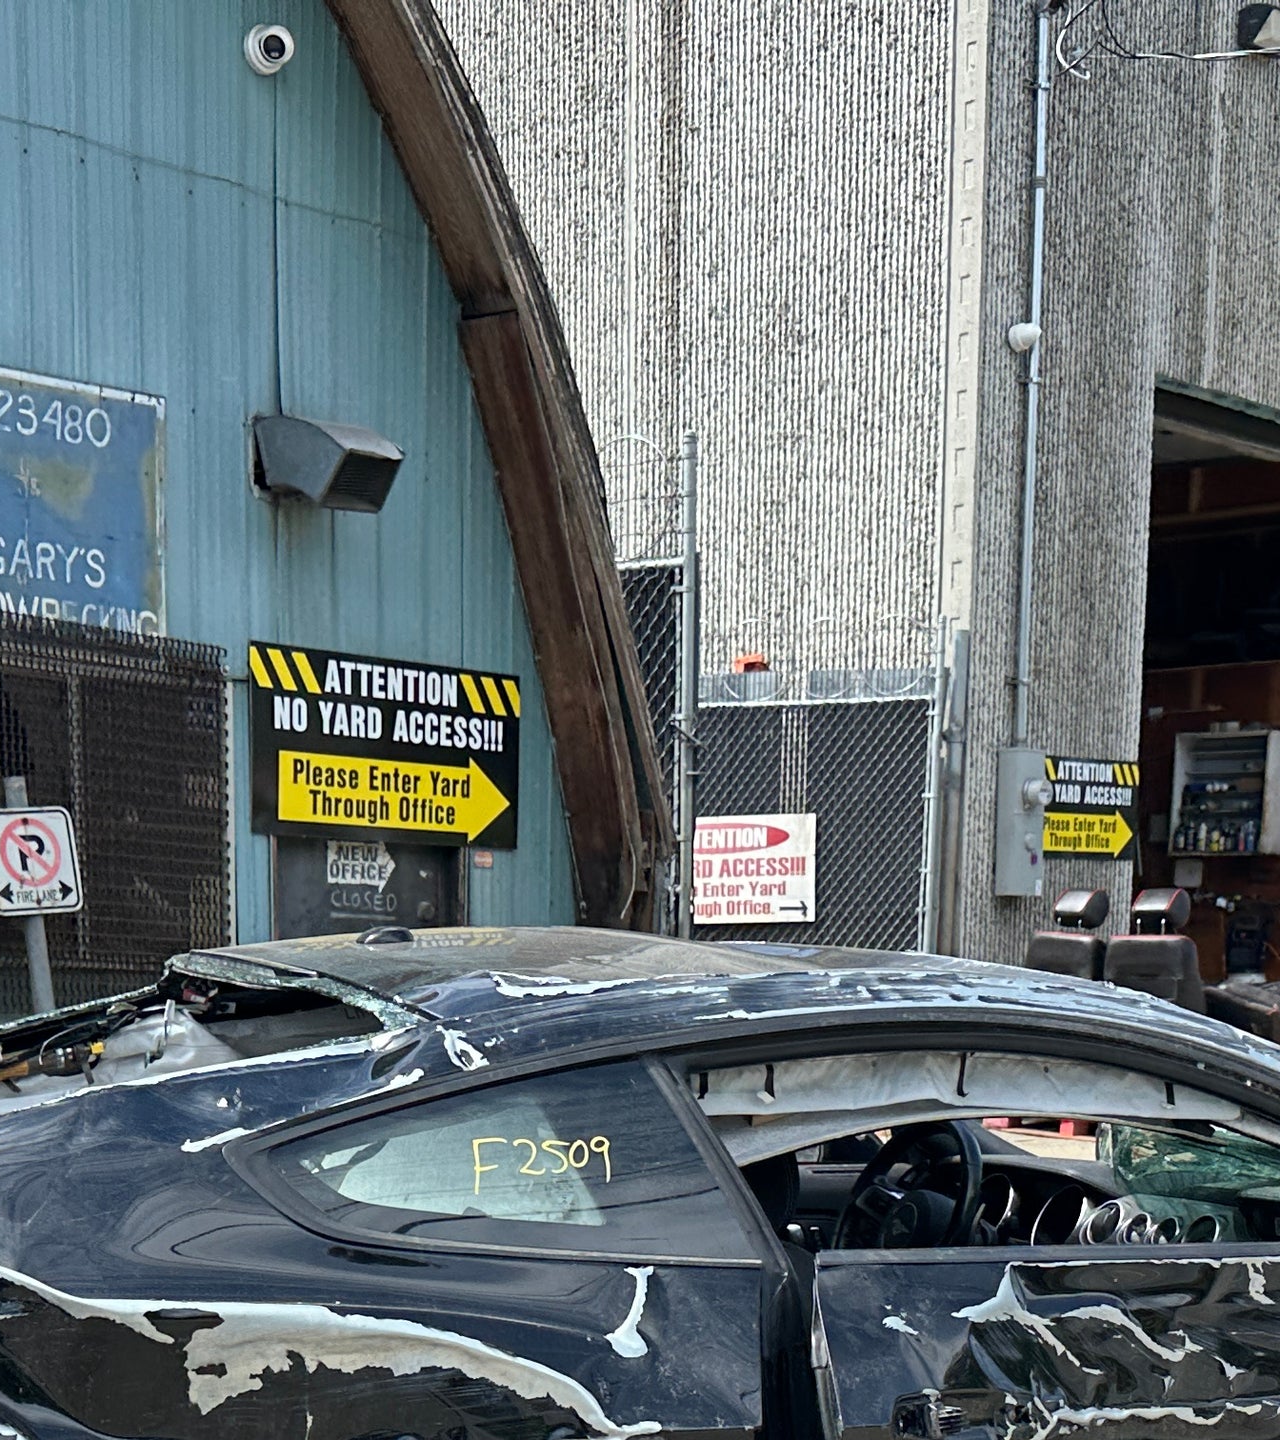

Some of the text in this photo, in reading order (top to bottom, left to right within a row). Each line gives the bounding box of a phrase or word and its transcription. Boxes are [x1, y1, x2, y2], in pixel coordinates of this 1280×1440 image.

[324, 659, 458, 708] ATTENTION
[273, 696, 504, 752] NO YARD ACCESS!!!
[292, 758, 470, 799] Please Enter Yard
[1057, 760, 1113, 783] ATTENTION
[1054, 783, 1132, 806] YARD ACCESS!!!
[309, 789, 456, 825] Through Office
[1073, 817, 1096, 833] Enter
[1099, 818, 1117, 834] Yard
[693, 826, 768, 849] TENTION
[1049, 833, 1110, 850] Through Office
[335, 842, 379, 862] NEW
[330, 860, 389, 880] OFFICE
[693, 856, 807, 879] RD ACCESS!!!
[16, 888, 58, 904] FIRE LANE
[703, 882, 744, 897] Enter
[749, 880, 787, 897] Yard
[330, 889, 397, 912] CLOSED
[472, 1135, 611, 1195] F2509
